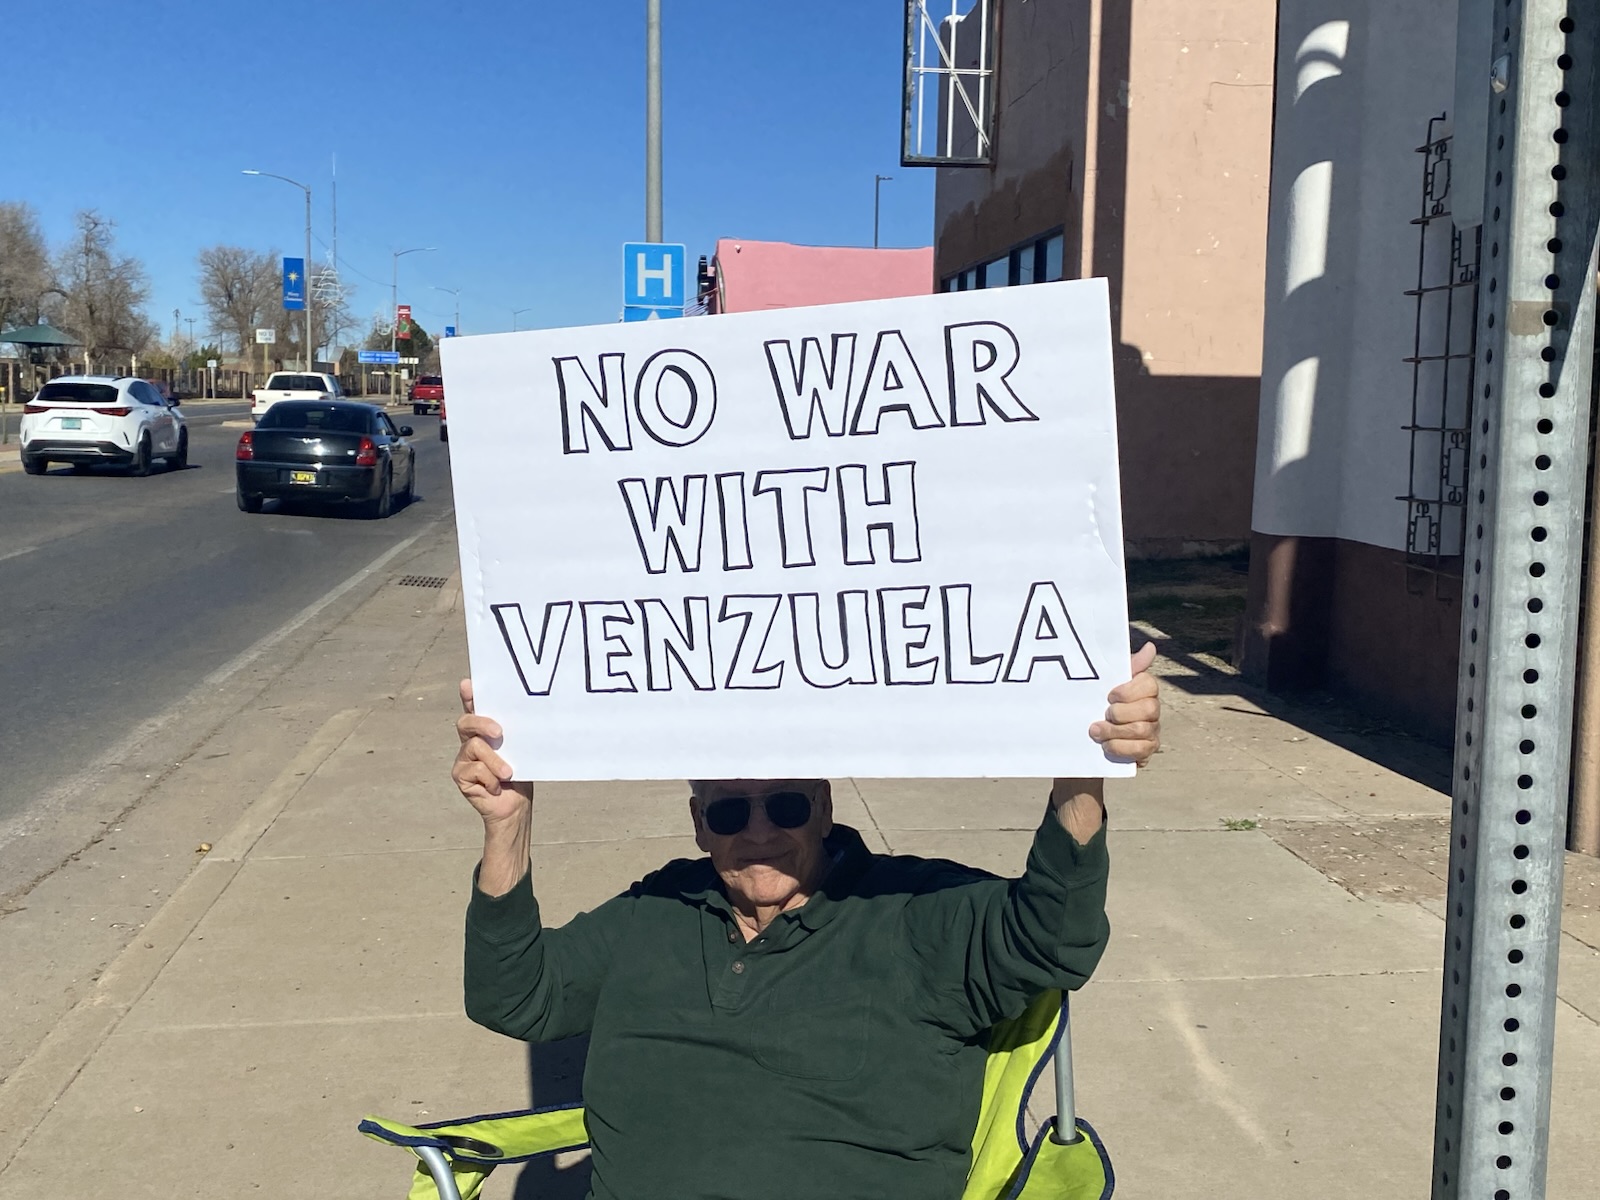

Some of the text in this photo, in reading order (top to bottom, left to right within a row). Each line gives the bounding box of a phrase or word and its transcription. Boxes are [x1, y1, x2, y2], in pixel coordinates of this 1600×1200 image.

[637, 253, 672, 297] H
[552, 321, 1039, 454] NO WAR
[617, 461, 921, 574] WITH
[490, 581, 1099, 696] VENZUELA
